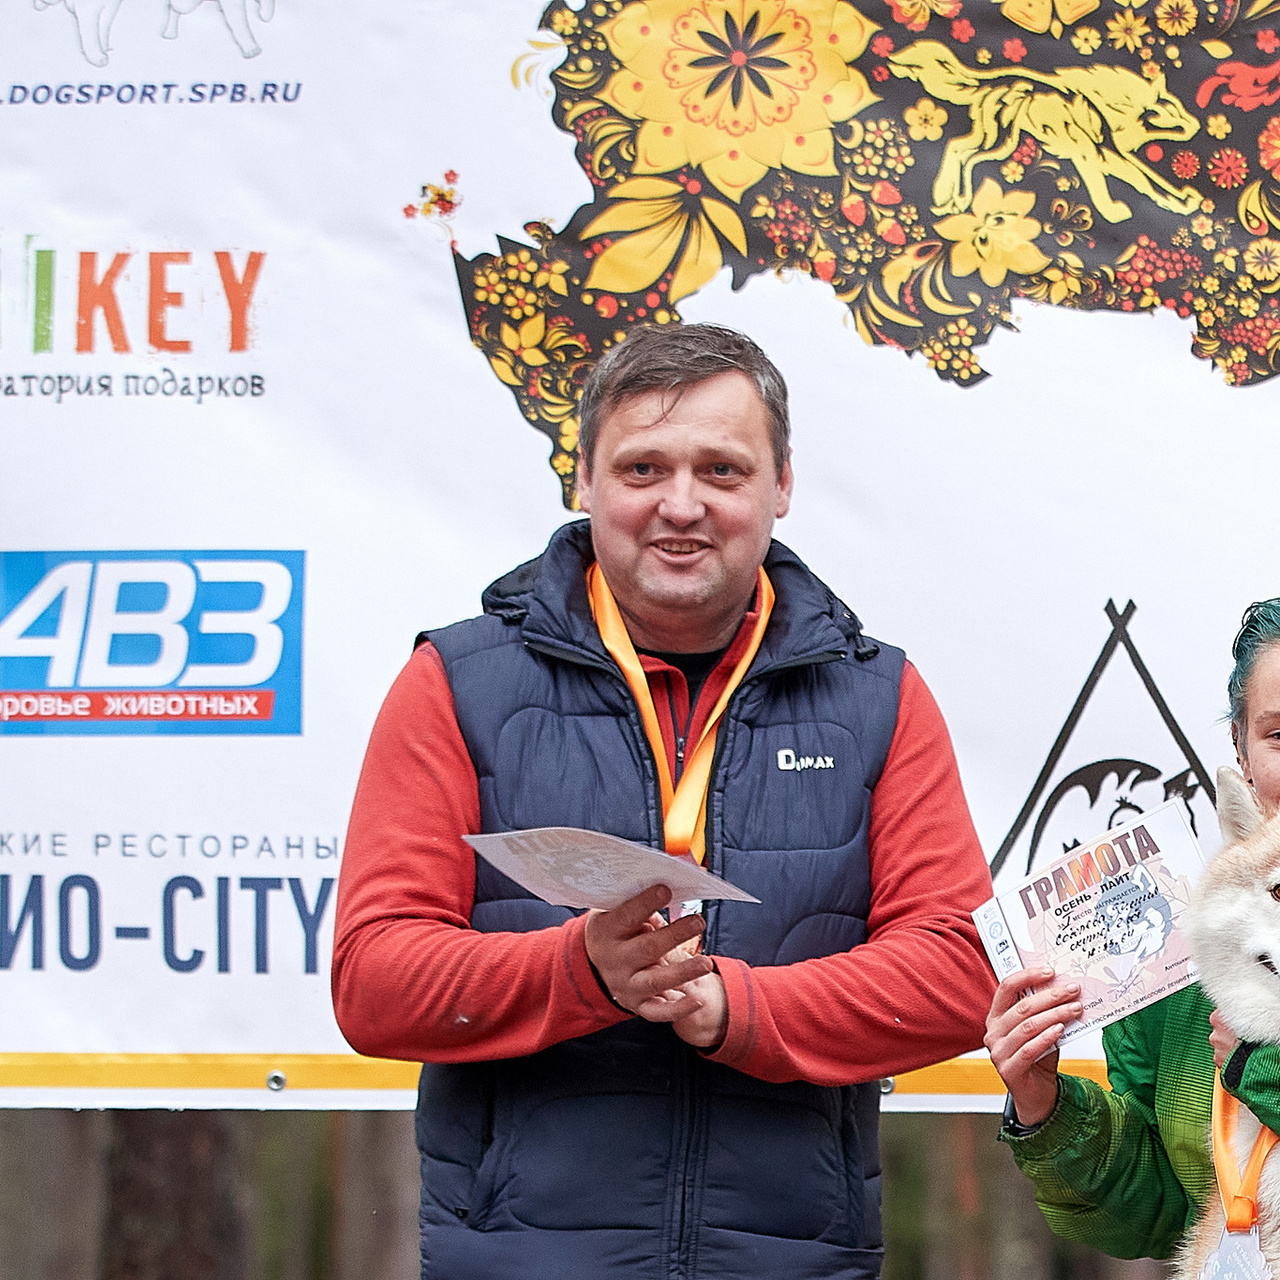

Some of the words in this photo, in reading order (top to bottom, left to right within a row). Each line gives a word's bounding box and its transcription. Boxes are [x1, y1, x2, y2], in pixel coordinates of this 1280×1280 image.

[0, 375, 114, 404] атория
[124, 367, 266, 404] подарков
[0, 560, 293, 687] АВЗ
[0, 694, 91, 720] ровье
[104, 694, 258, 716] животных
[94, 834, 340, 860] РЕСТОРАНЫ
[1019, 825, 1160, 919] ГРАМОТА
[1055, 893, 1092, 917] ОСЕНЬ
[1100, 872, 1131, 894] ЛАЙТ
[1094, 885, 1141, 911] НАГРАЖДАЕТСЯ
[1083, 997, 1104, 1011] СУДЬЯ
[1092, 1012, 1115, 1026] РОССИИ
